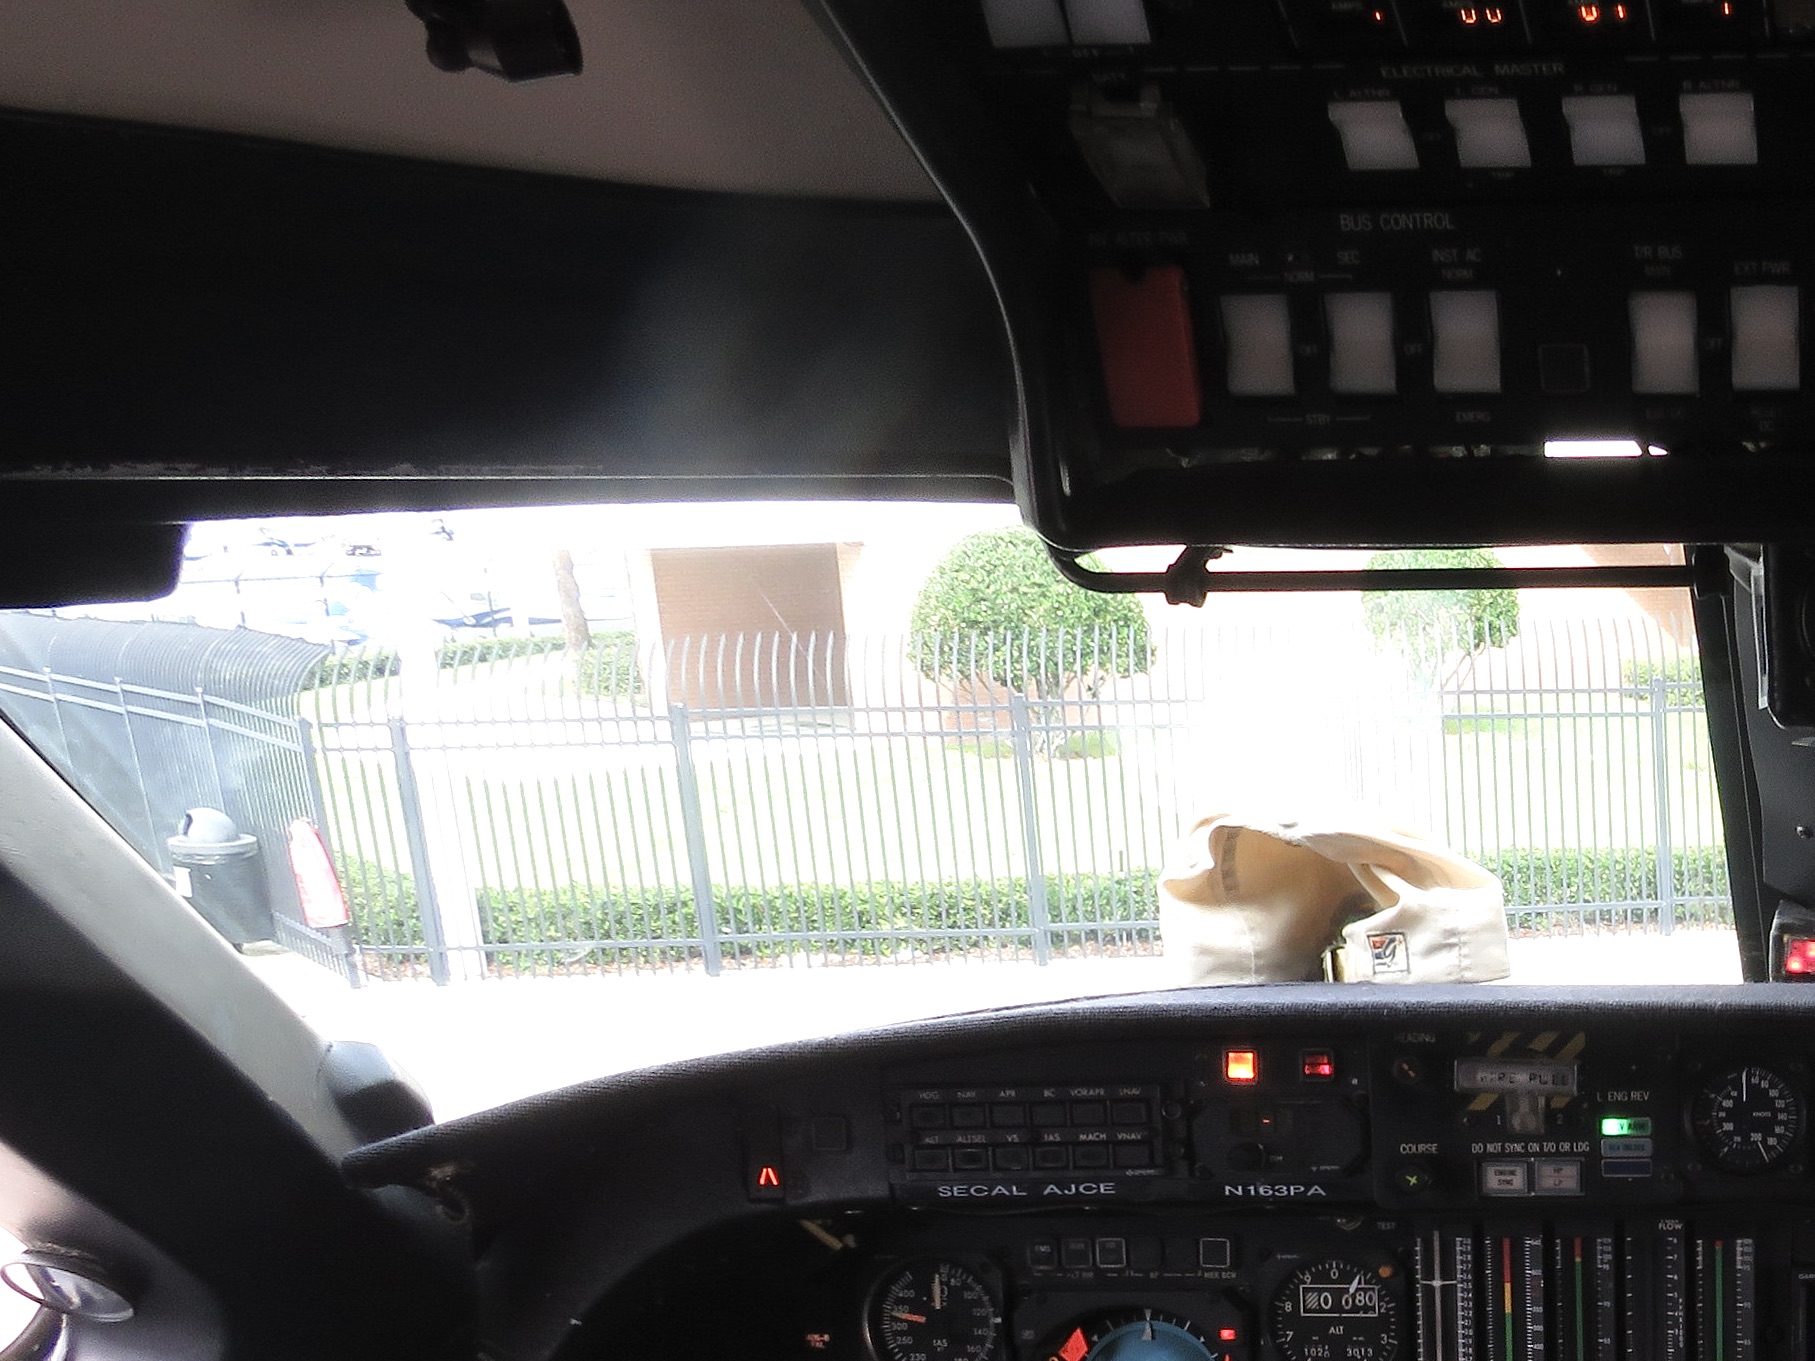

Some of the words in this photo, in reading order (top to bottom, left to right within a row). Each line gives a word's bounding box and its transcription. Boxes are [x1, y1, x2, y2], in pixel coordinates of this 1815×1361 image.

[1380, 64, 1481, 79] ELECTRICAL
[1495, 62, 1564, 77] MASTER
[1340, 213, 1372, 231] BUS
[1379, 212, 1455, 231] CONTROL
[1597, 1092, 1601, 1101] L
[1608, 1092, 1628, 1101] ENG
[1631, 1092, 1650, 1101] REV
[1400, 1143, 1438, 1154] COURSE
[1472, 1143, 1483, 1153] DO
[1487, 1143, 1501, 1153] NOT
[1505, 1143, 1525, 1153] SYNC
[1528, 1143, 1539, 1152] ON
[1543, 1142, 1556, 1152] T/O
[1560, 1142, 1571, 1152] OR
[1574, 1142, 1590, 1152] LDG
[938, 1185, 1027, 1197] SECAL
[1043, 1183, 1116, 1195] AJCE
[1225, 1185, 1326, 1196] N163PA
